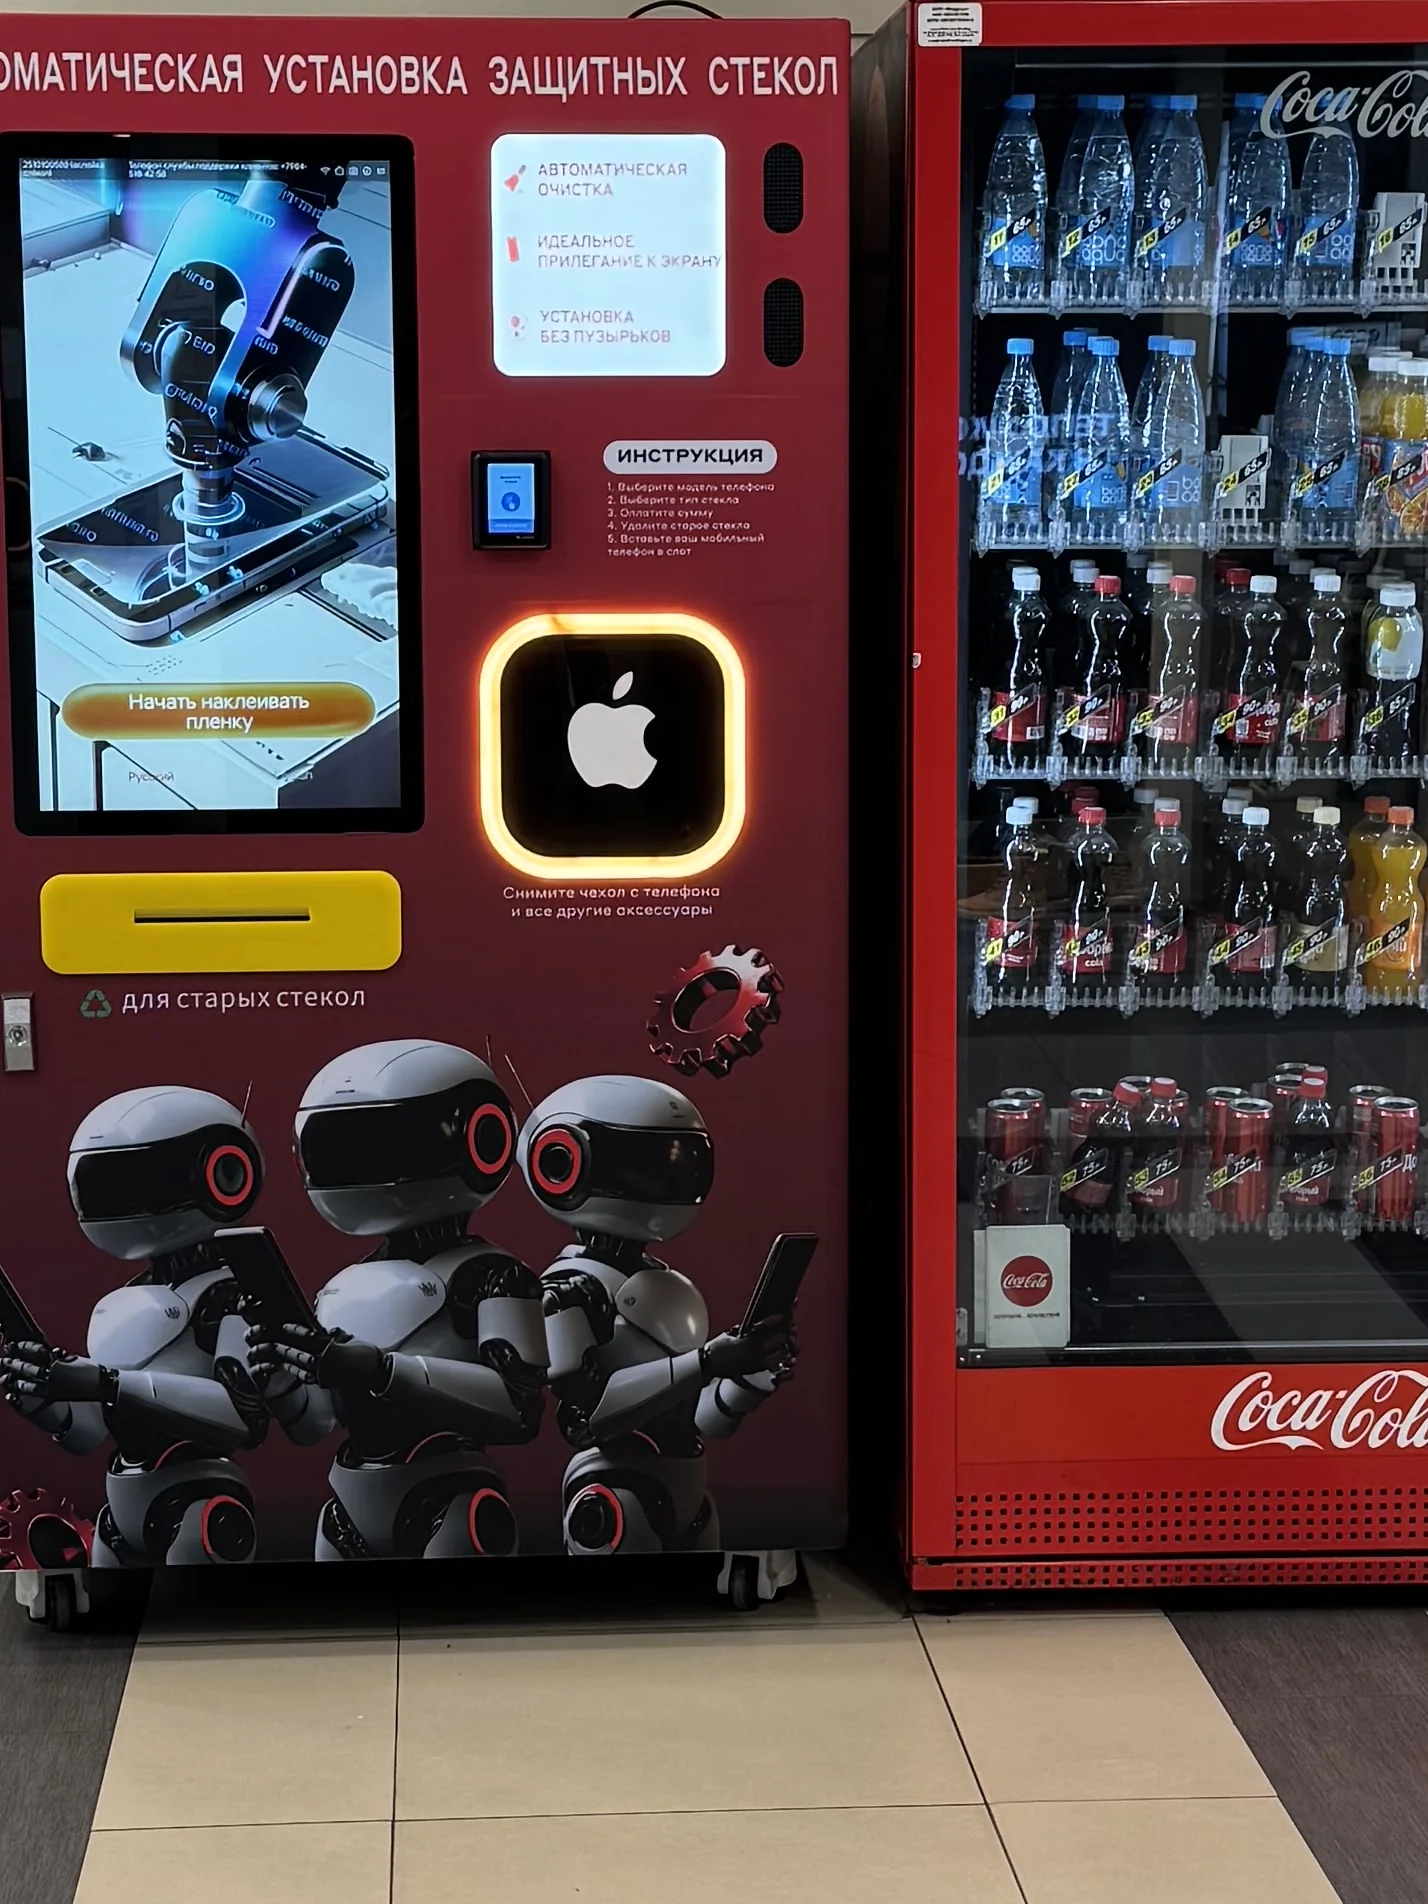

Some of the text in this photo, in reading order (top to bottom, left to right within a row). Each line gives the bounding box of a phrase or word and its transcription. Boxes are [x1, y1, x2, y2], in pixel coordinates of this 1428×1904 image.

[264, 53, 468, 95] УСТАНОВКА
[488, 56, 689, 103] ЗАЩИТНЫХ
[707, 56, 838, 96] СТЕКОЛ
[538, 163, 687, 176] АВТОМАТИЧЕСКАЯ
[538, 182, 613, 196] ОЧИСТКА
[538, 235, 635, 248] ИДЕАЛЬНОЕ
[538, 255, 722, 268] ПРИЛЕГАНИЕ К ЭКРАНУ
[540, 310, 634, 323] УСТАНОВКА
[540, 330, 671, 343] БЕЗ ПУЗЫРЬКОВ
[618, 448, 763, 465] ИНСТРУКЦИЯ
[618, 482, 673, 494] Выберите
[677, 484, 718, 493] модель
[721, 482, 775, 493] телефона
[620, 496, 676, 505] Выберите
[701, 497, 740, 505] стекла
[620, 508, 675, 517] Оплатите
[677, 510, 714, 519] сумму
[621, 521, 668, 531] Удалите
[670, 522, 709, 530] старое
[712, 522, 750, 530] стекло
[620, 534, 672, 543] Вставьте
[675, 535, 698, 543] ваш
[701, 532, 765, 543] мобильный
[608, 547, 692, 557] телефон в слот
[128, 693, 310, 710] Начать наклеивать
[186, 715, 254, 734] пленку
[503, 884, 721, 900] Снимите чехол с телефона
[511, 904, 713, 919] и все другие аксессуары
[121, 988, 366, 1013] для старых стекол
[1003, 1272, 1050, 1289] Coca-Cola
